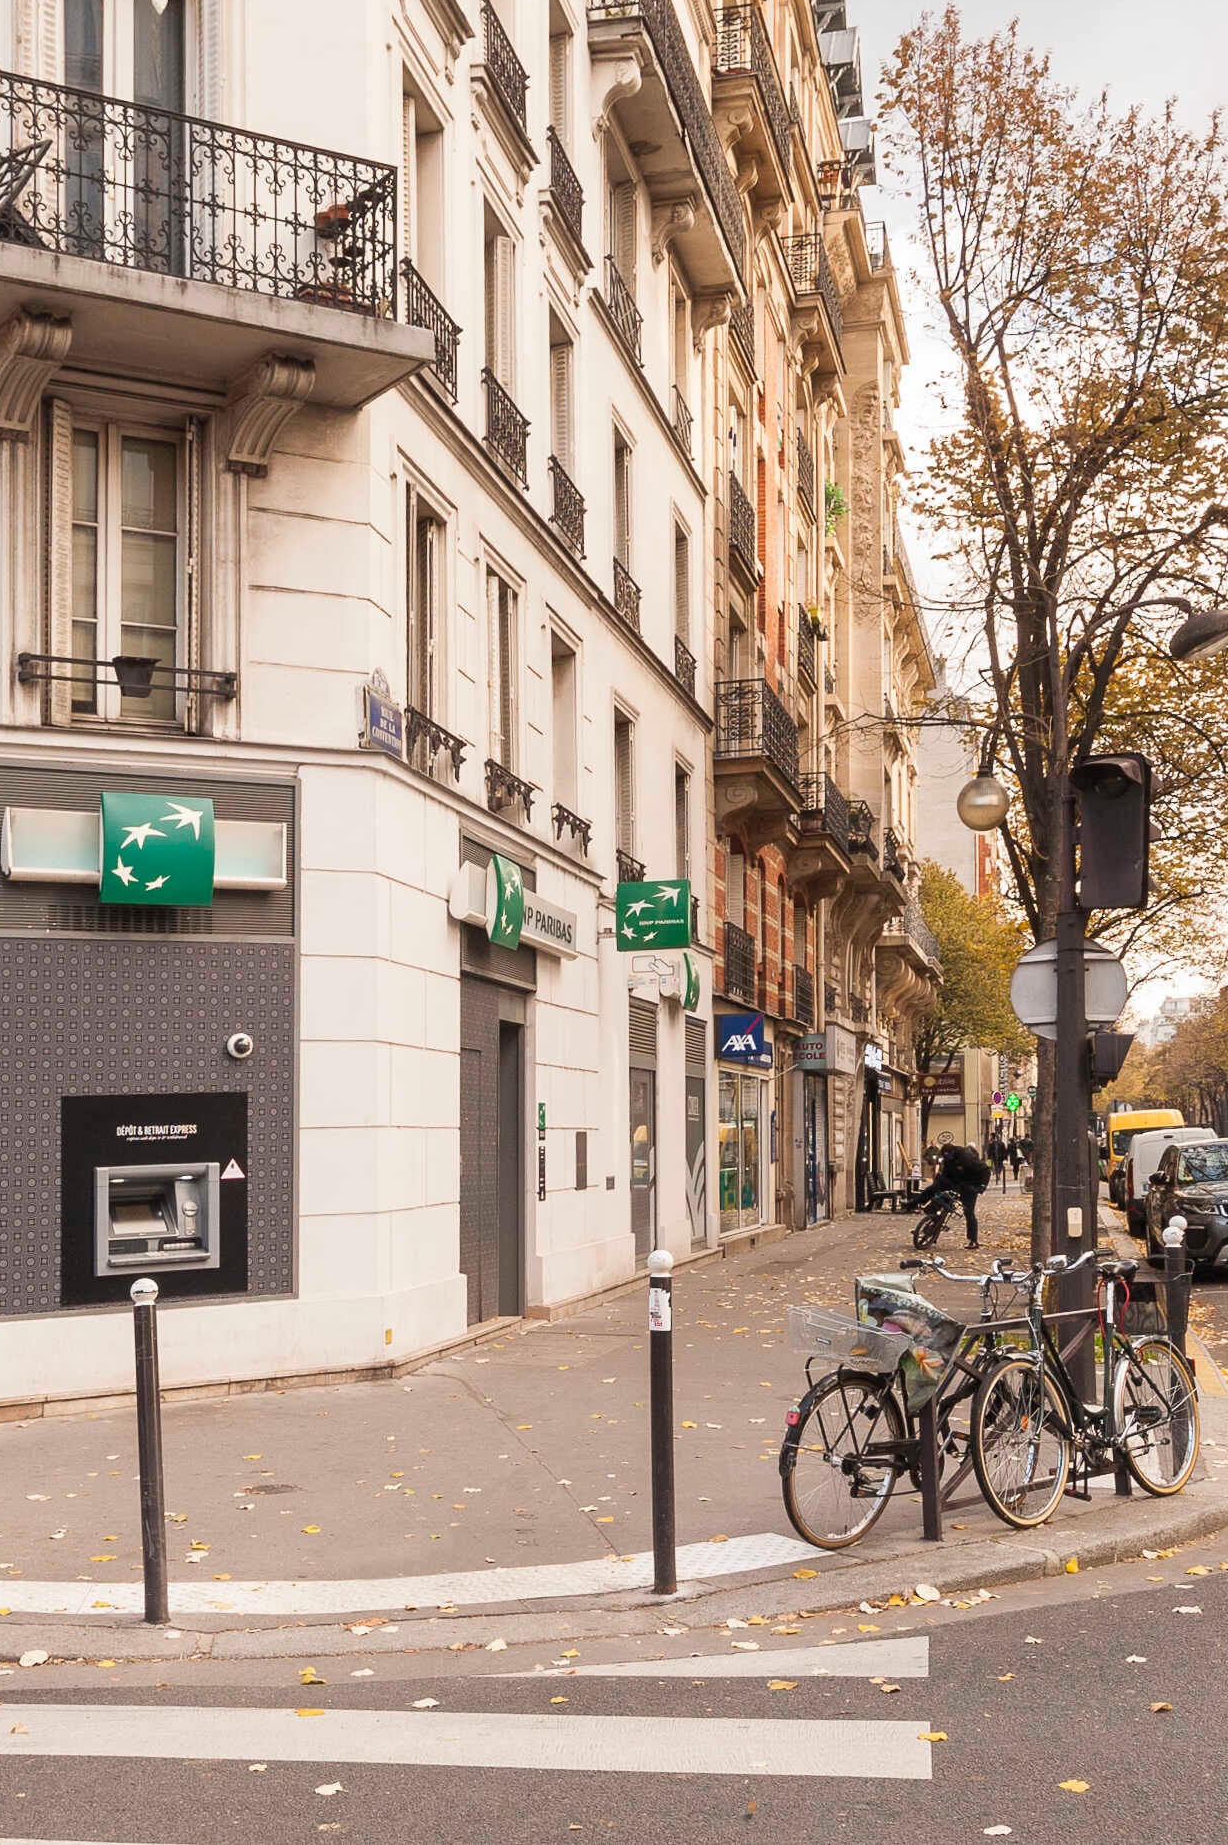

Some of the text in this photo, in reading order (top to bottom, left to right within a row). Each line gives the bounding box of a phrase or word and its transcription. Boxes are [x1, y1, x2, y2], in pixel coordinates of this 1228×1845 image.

[379, 716, 388, 730] DE
[535, 910, 572, 944] PARIBAS
[722, 1034, 757, 1052] AXA
[796, 1042, 824, 1050] AUTO
[116, 1124, 197, 1136] DÉPÔT & RETRAIT EXPRESS
